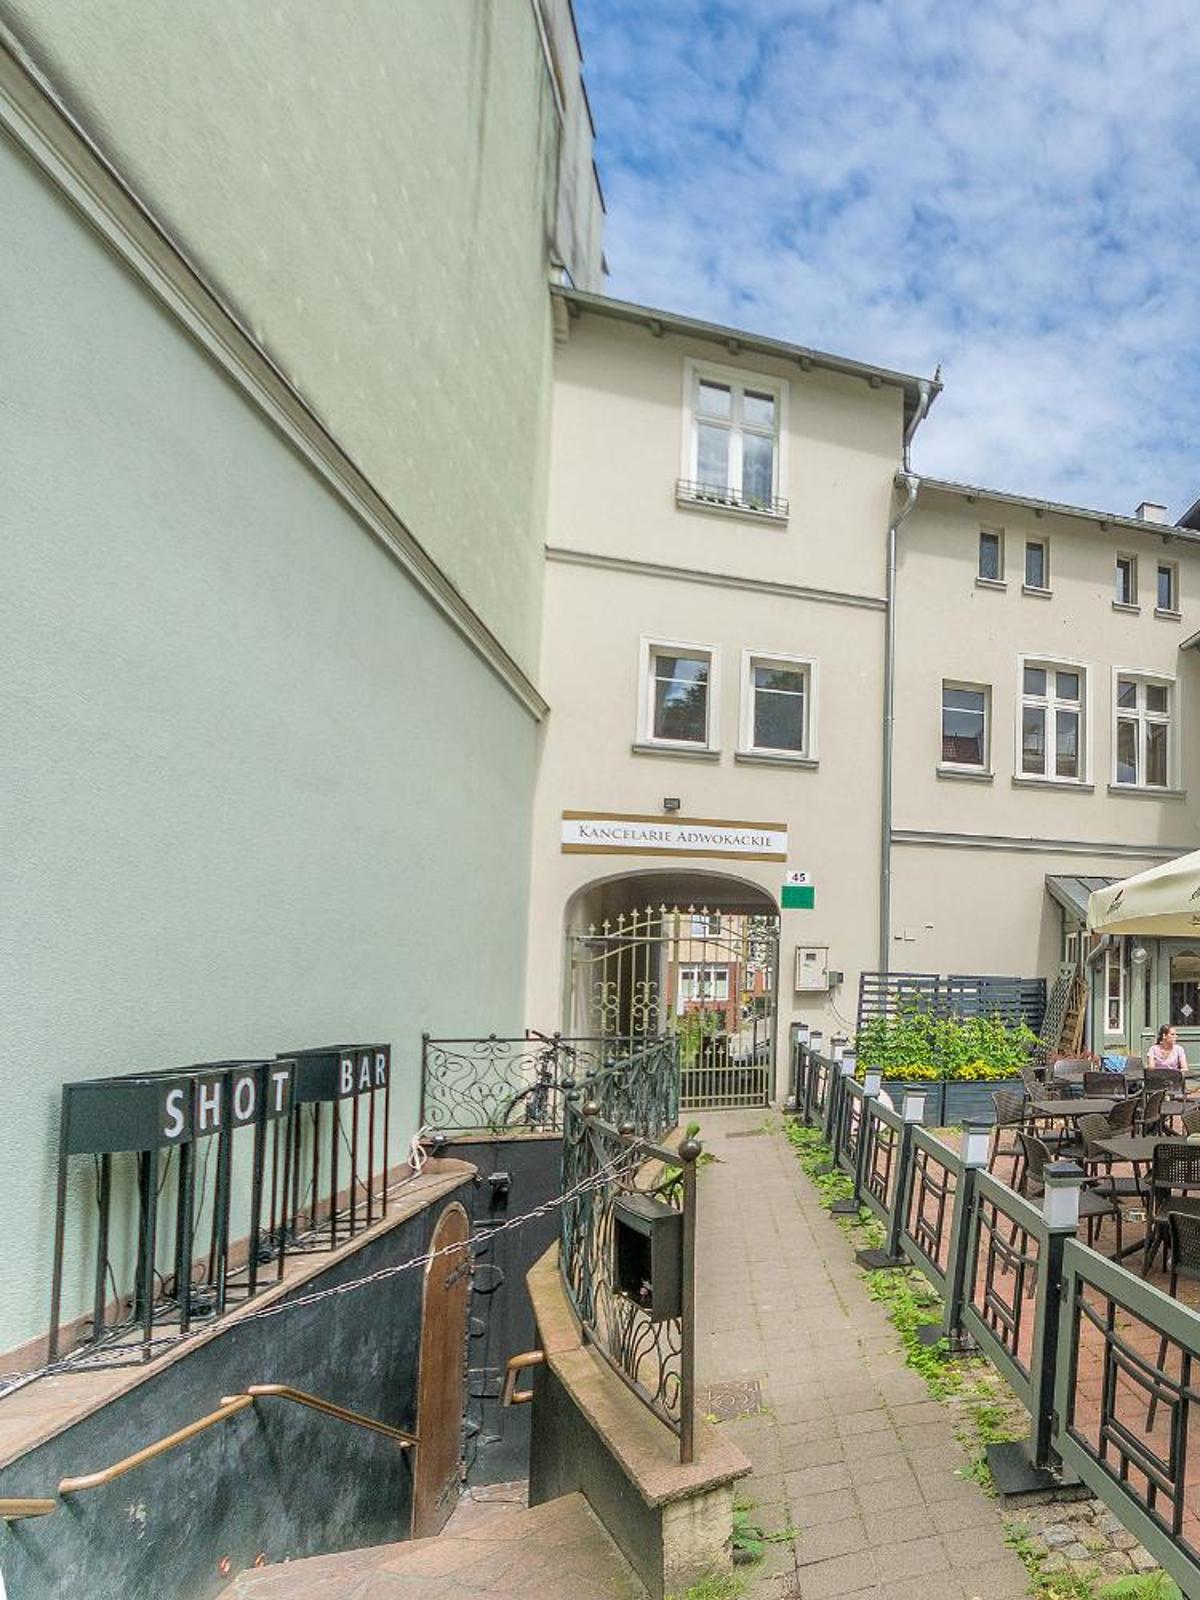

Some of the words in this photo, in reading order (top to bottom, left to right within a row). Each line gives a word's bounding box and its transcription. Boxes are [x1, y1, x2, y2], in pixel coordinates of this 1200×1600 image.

[578, 825, 672, 842] KANCELARIE
[676, 832, 773, 847] ADWOKACKIE
[791, 873, 806, 882] 45
[163, 1071, 289, 1138] SHOT
[340, 1053, 386, 1095] BAR
